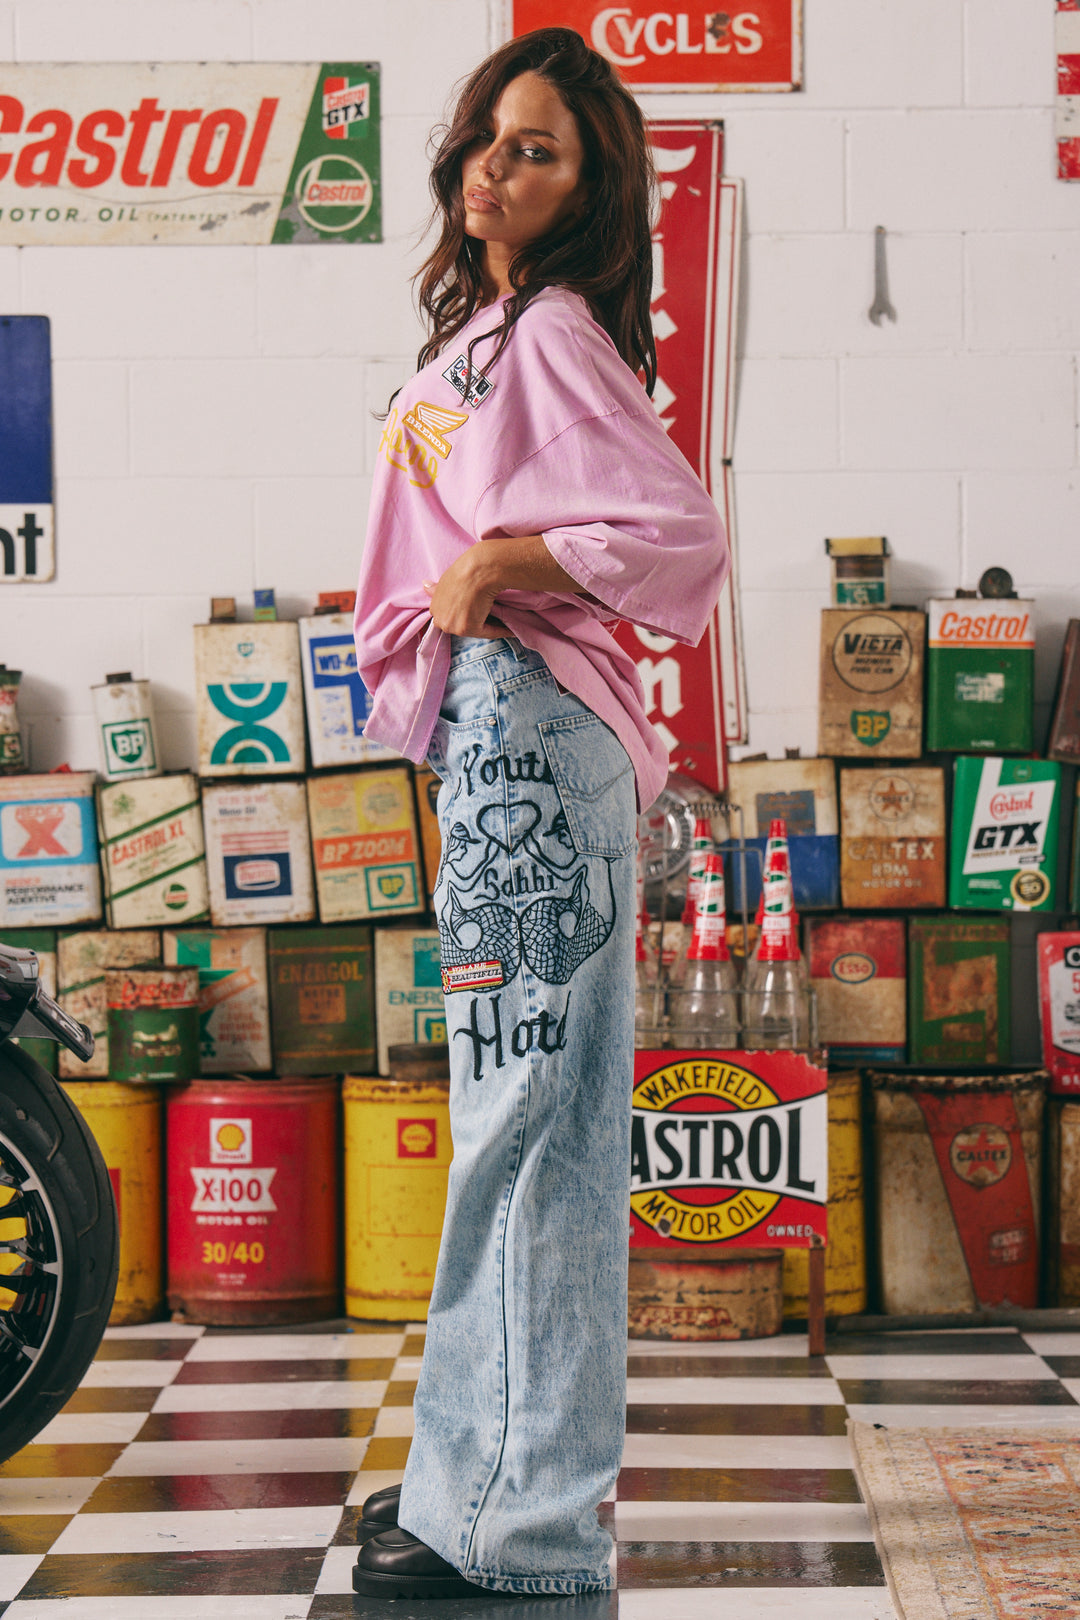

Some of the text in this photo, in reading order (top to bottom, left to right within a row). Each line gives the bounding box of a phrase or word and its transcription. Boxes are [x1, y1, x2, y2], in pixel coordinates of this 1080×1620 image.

[591, 7, 763, 67] CYCLES
[328, 101, 364, 126] GTX
[308, 184, 367, 201] Castrol
[0, 208, 79, 222] OTOR
[98, 208, 139, 221] OIL
[406, 414, 447, 454] BRENDA
[939, 612, 1029, 640] Castrol
[857, 715, 888, 738] BP
[115, 731, 144, 757] BP
[464, 743, 556, 797] Yout
[989, 790, 1035, 822] Castrol
[973, 821, 1042, 850] GTX
[322, 835, 408, 864] BP ZOOM
[848, 841, 935, 861] CALTEX
[380, 877, 403, 895] BP
[278, 960, 364, 985] ENERGOL
[838, 962, 870, 975] Esso
[430, 1021, 447, 1043] B
[640, 1065, 762, 1107] WAKEFIELD
[631, 1107, 816, 1193] ASTROL
[957, 1149, 1007, 1162] CALTEX
[201, 1178, 262, 1202] X-100
[196, 1215, 268, 1226] MOTOR OIL
[641, 1194, 765, 1236] MOTOR OIL
[767, 1224, 813, 1237] OWNED
[201, 1241, 265, 1265] 30/40
